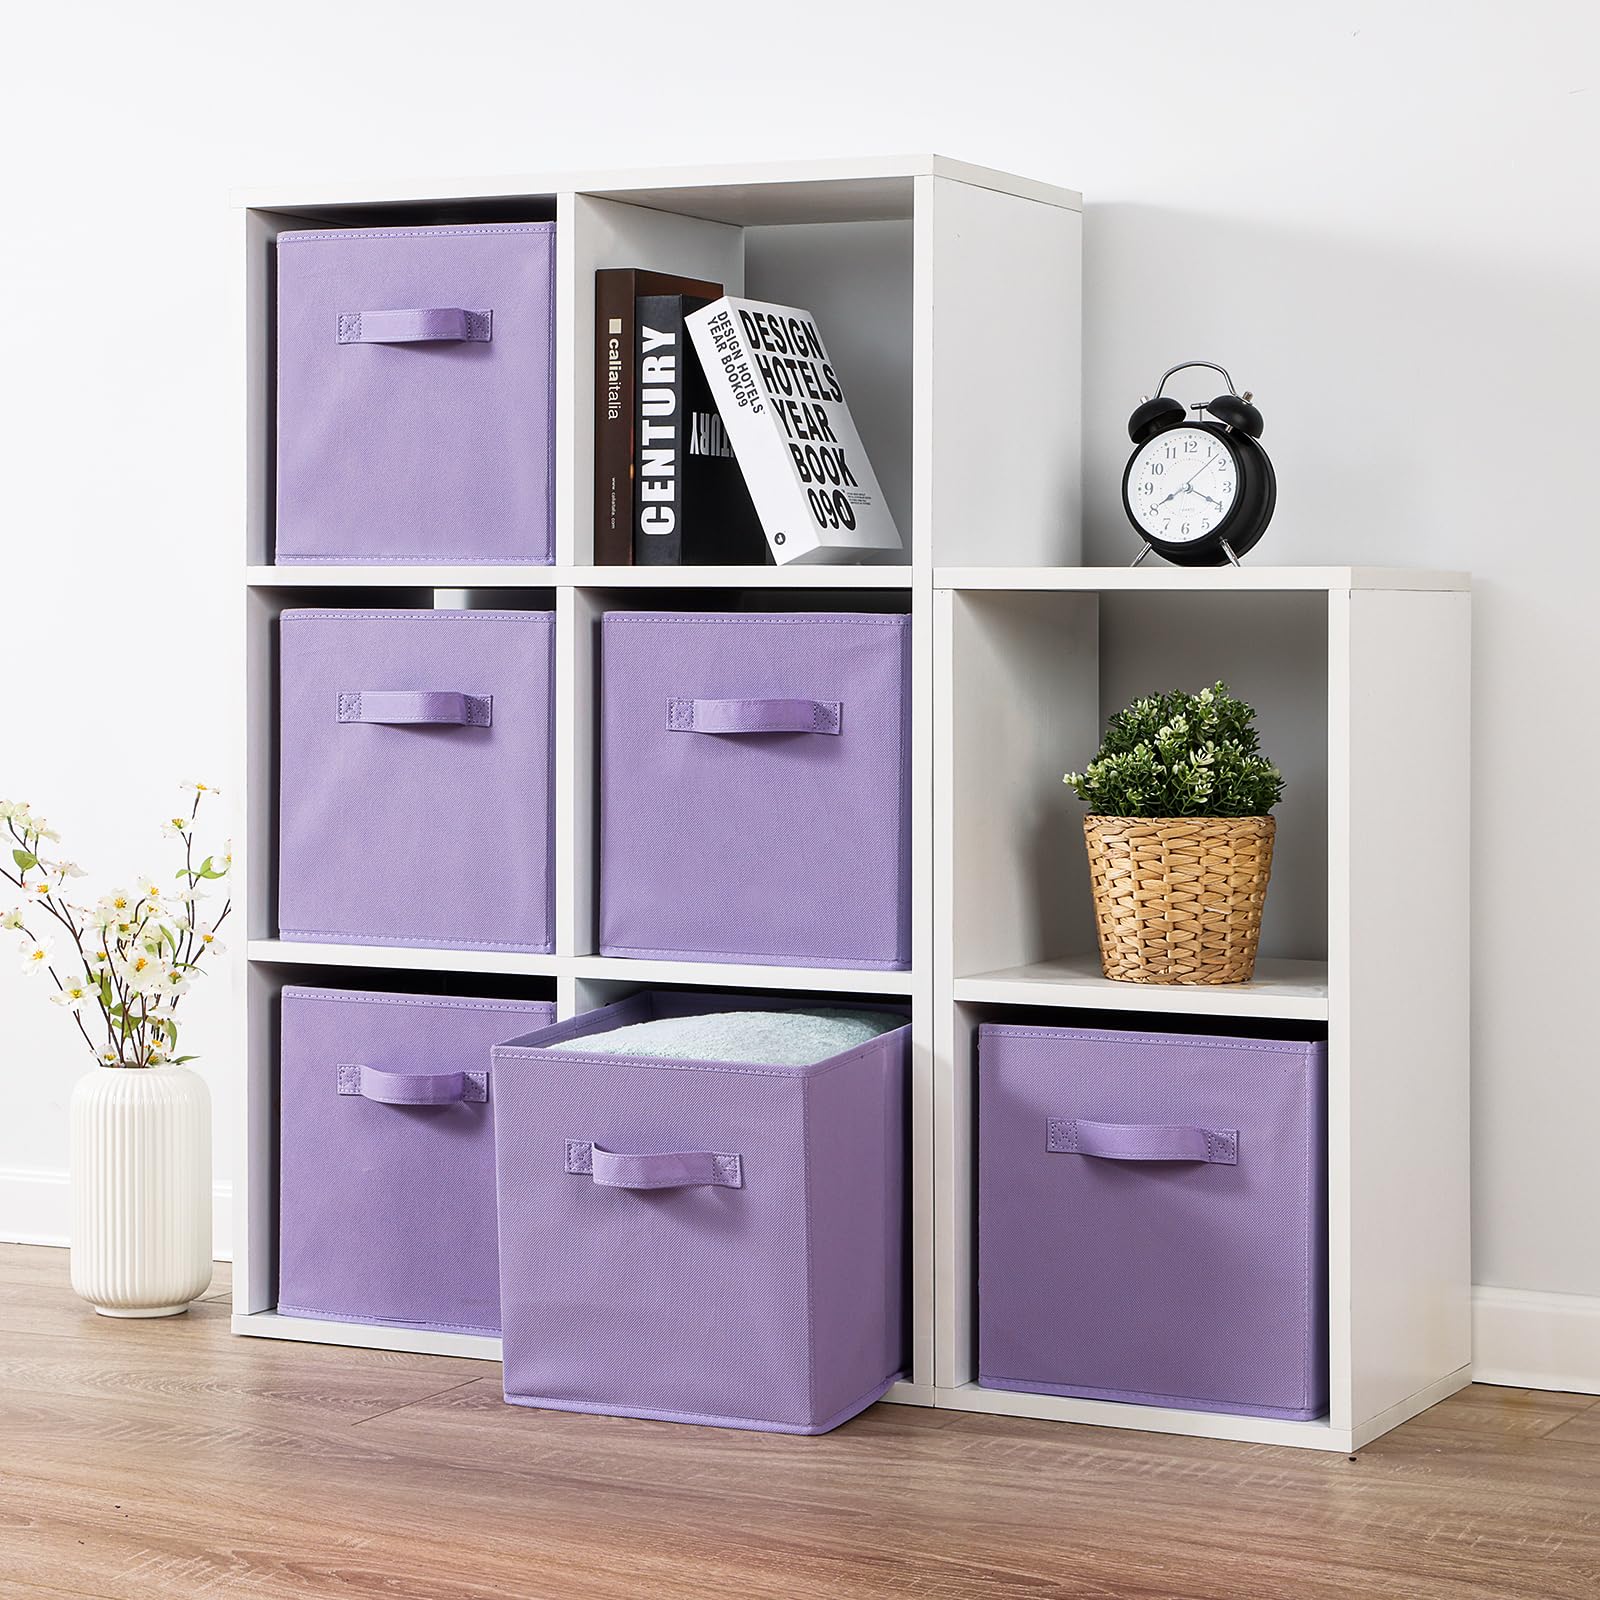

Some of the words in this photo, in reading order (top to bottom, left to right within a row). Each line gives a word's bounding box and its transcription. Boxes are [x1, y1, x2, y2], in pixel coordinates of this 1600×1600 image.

[707, 316, 728, 353] YEAR
[738, 309, 825, 361] DESIGN
[717, 311, 744, 361] DESIGN
[737, 362, 764, 415] HOTELS
[608, 338, 622, 420] caliaitalia
[754, 353, 843, 403] HOTELS
[770, 398, 838, 443] YEAR
[640, 325, 676, 535] CENTURY
[690, 411, 734, 458] TURY
[1166, 447, 1176, 459] 11
[1184, 440, 1198, 453] 12
[1207, 446, 1211, 457] 1
[788, 443, 858, 487] BOOK
[1151, 463, 1164, 475] 10
[1218, 459, 1226, 471] 2
[1145, 482, 1153, 495] 9
[1223, 481, 1231, 493] 3
[1149, 503, 1158, 516] 8
[1214, 501, 1223, 512] 4
[1163, 518, 1171, 530] 7
[1181, 522, 1190, 535] 6
[1202, 518, 1210, 529] 5
